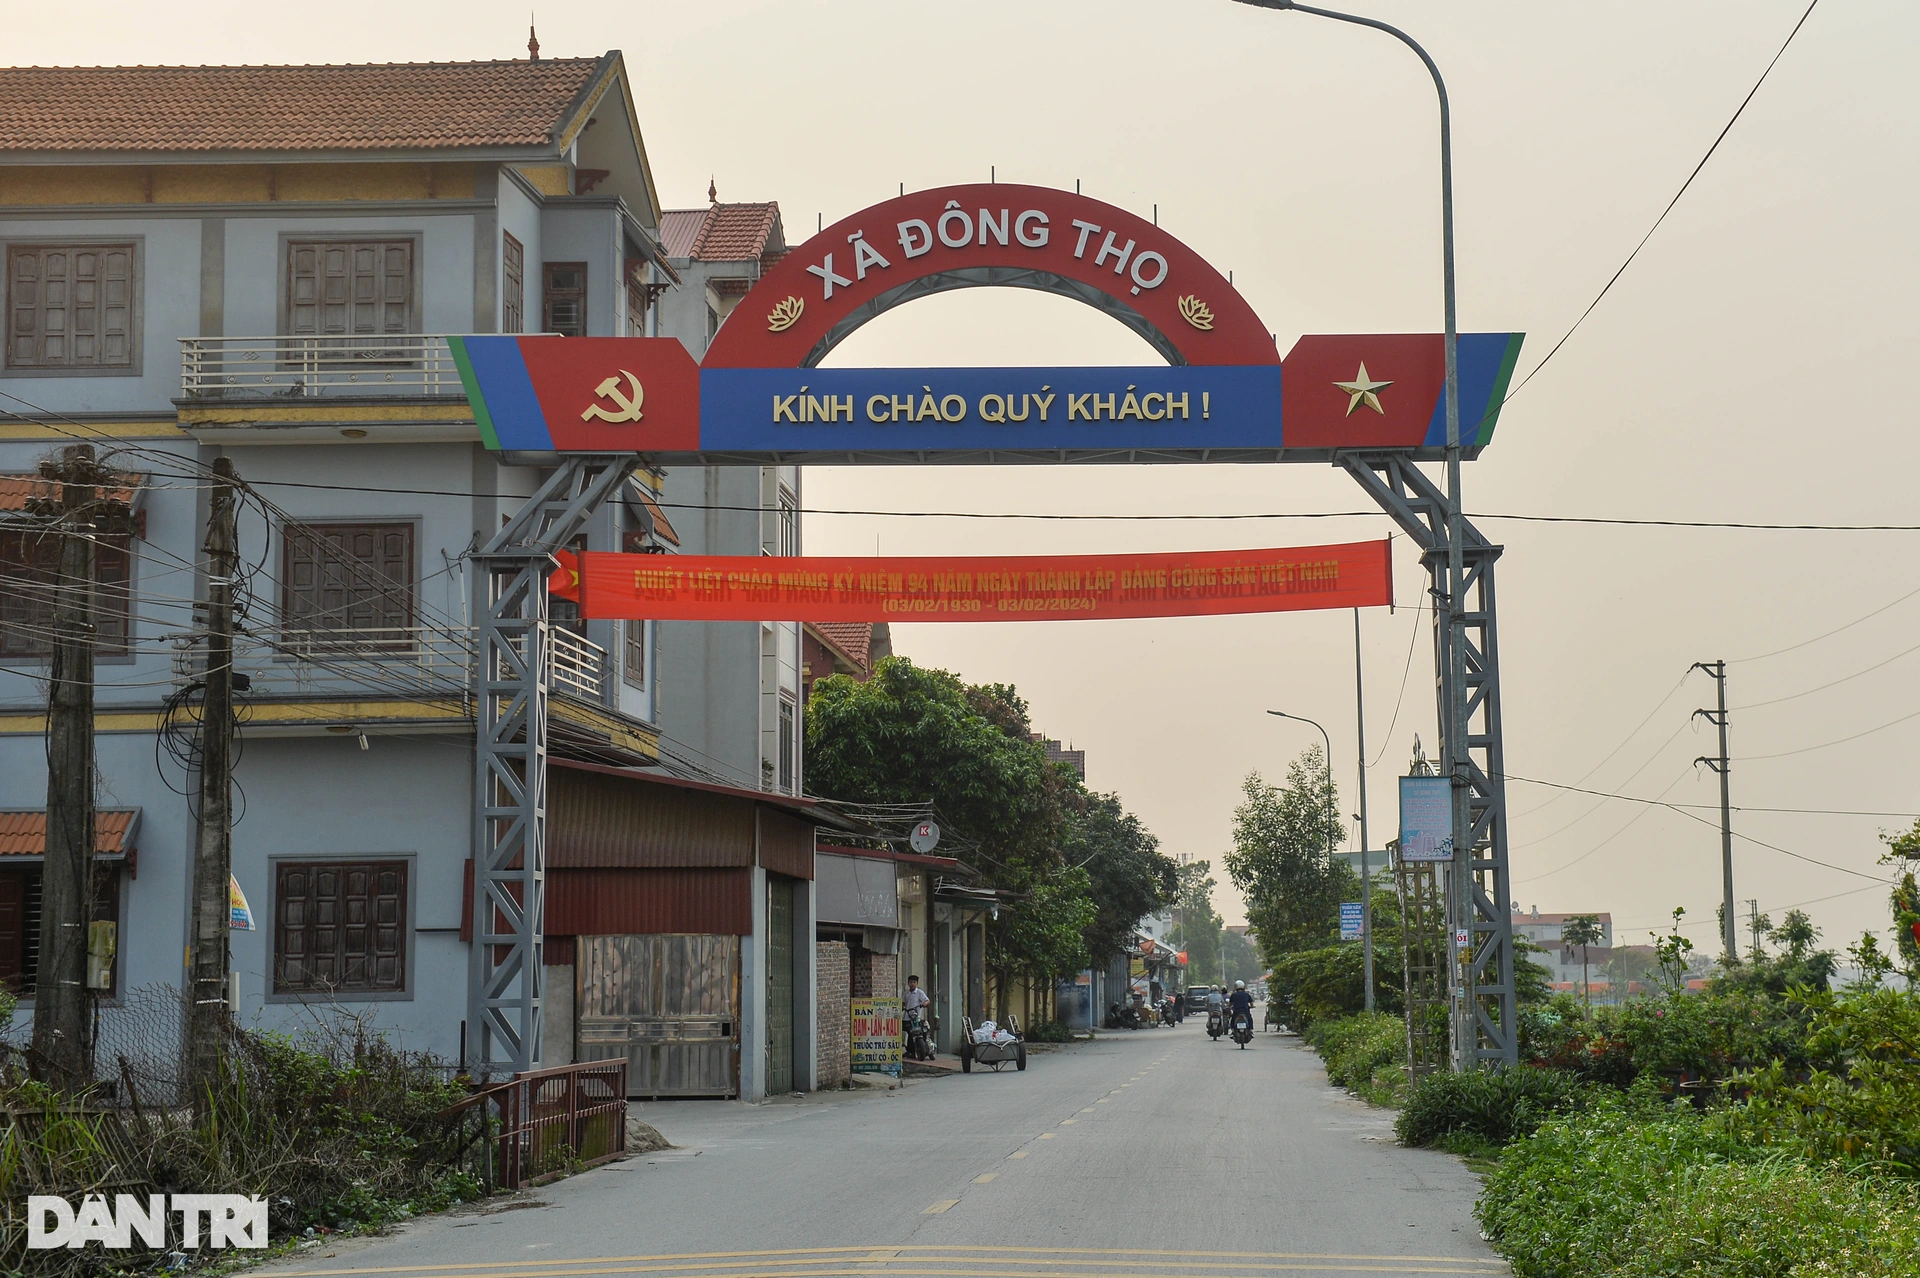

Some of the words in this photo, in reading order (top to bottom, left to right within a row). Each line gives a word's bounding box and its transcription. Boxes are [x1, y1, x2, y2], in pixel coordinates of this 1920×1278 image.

[805, 229, 891, 300] XÃ
[897, 200, 1051, 260] ĐÔNG
[1071, 219, 1170, 296] THỌ
[773, 386, 854, 423] KÍNH
[866, 386, 967, 423] CHÀO
[978, 385, 1056, 424] QUÝ
[1067, 384, 1189, 421] KHÁCH
[634, 566, 684, 593] NHIỆT
[689, 567, 723, 594] LIỆT
[727, 568, 773, 590] CHÀO
[778, 568, 829, 592] MỪNG
[859, 569, 902, 596] NIỆM
[908, 572, 928, 592] 94
[933, 569, 971, 593] NĂM
[976, 568, 1021, 592] NGÀY
[1026, 567, 1081, 592] THÀNH
[1085, 566, 1116, 595] LẬP
[1121, 563, 1167, 590] ĐẢNG
[1171, 564, 1217, 591] CỘNG
[1221, 560, 1256, 586] SẢN
[1260, 560, 1295, 586] VIỆT
[1300, 560, 1339, 581] NAM
[882, 599, 981, 613] (03/02/1930
[998, 597, 1096, 612] 03/02/2024)
[854, 1007, 874, 1016] BÁN
[853, 1038, 873, 1049] THUỐC
[874, 1039, 887, 1049] TRỪ
